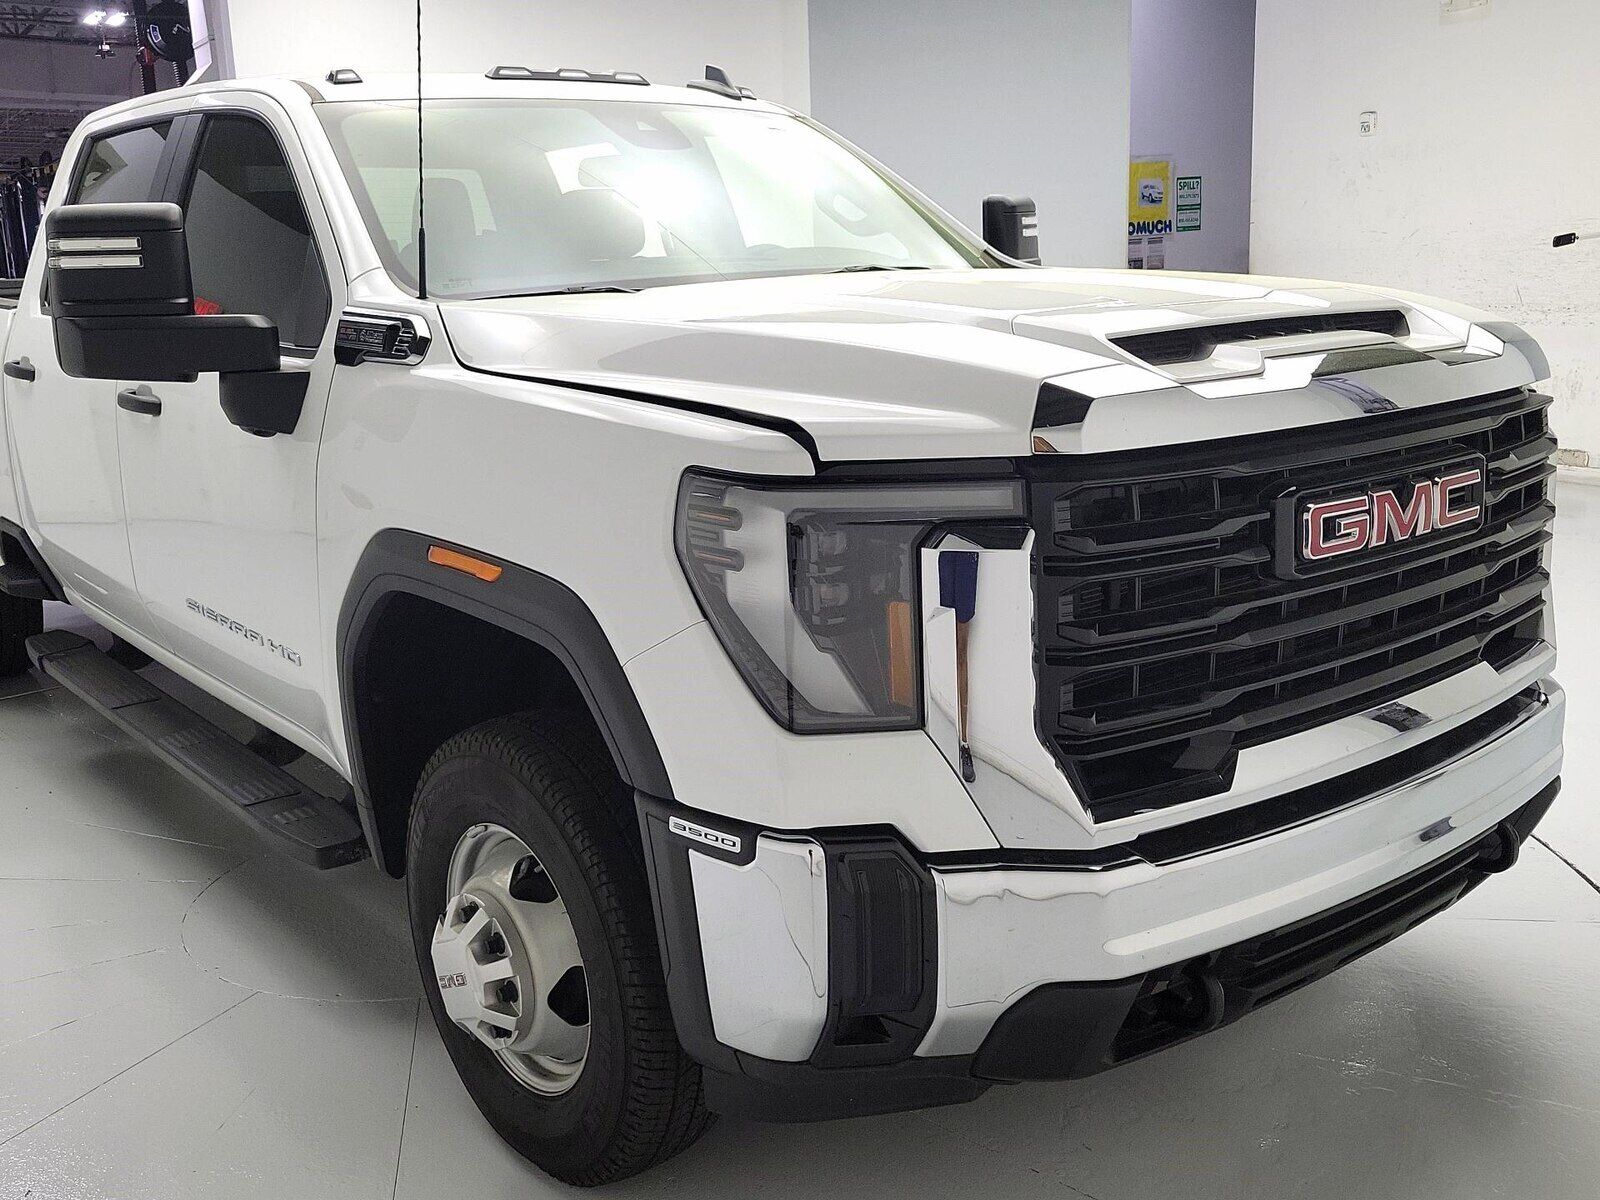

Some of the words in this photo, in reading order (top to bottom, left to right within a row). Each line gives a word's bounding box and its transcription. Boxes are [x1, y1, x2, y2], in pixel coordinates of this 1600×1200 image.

[1178, 181, 1200, 191] SPILL?
[1303, 469, 1481, 560] GMC
[185, 597, 264, 646] SIERRA
[267, 638, 302, 667] HD
[672, 821, 737, 847] 3500
